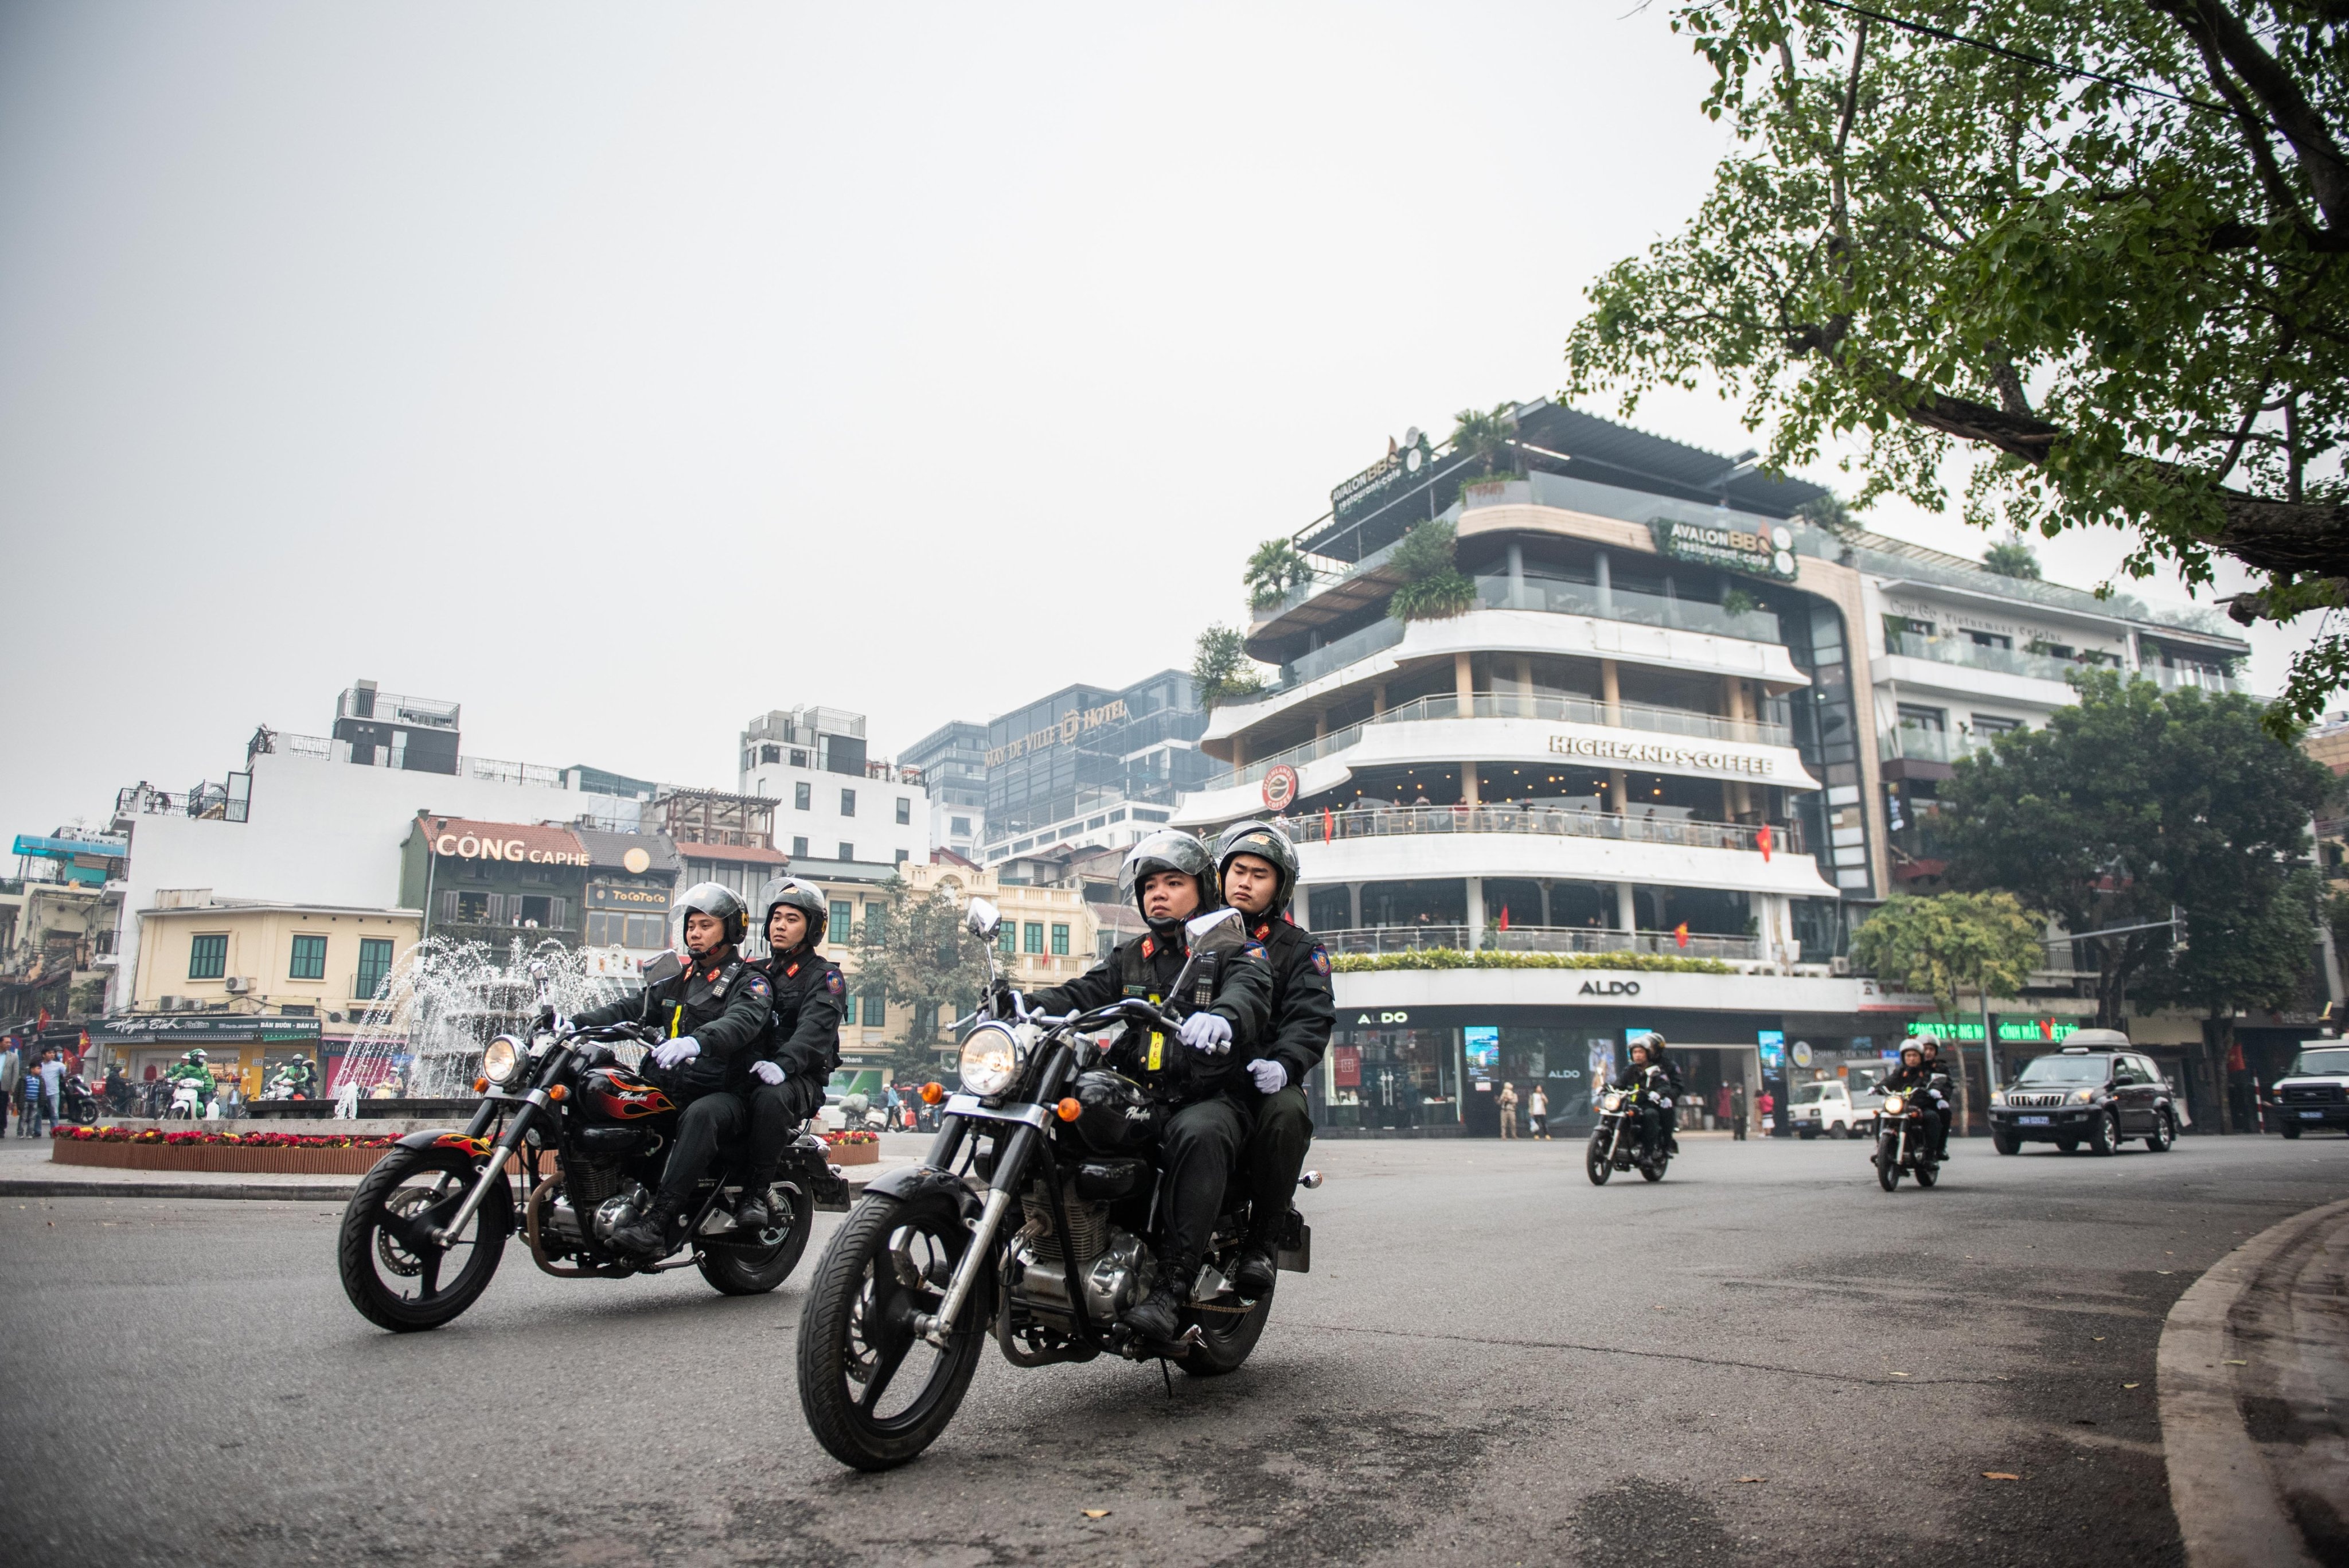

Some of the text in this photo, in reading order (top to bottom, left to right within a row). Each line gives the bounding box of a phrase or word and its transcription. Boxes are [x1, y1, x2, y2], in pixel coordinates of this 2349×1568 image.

[1333, 473, 1367, 501] AVALON
[1671, 522, 1728, 546] AVALON
[985, 699, 1126, 768] MAY DE VILLE HOTEL
[1550, 735, 1774, 774] HIGHLANDS COFFEE
[1263, 767, 1293, 790] HIGHLANDS
[1267, 793, 1291, 808] COFFEE
[436, 831, 590, 867] CỘNG CAPHE
[1578, 980, 1640, 996] ALDO
[1357, 1012, 1408, 1024] ALDO
[1549, 1070, 1580, 1078] ALDO
[618, 1091, 648, 1102] Phantom
